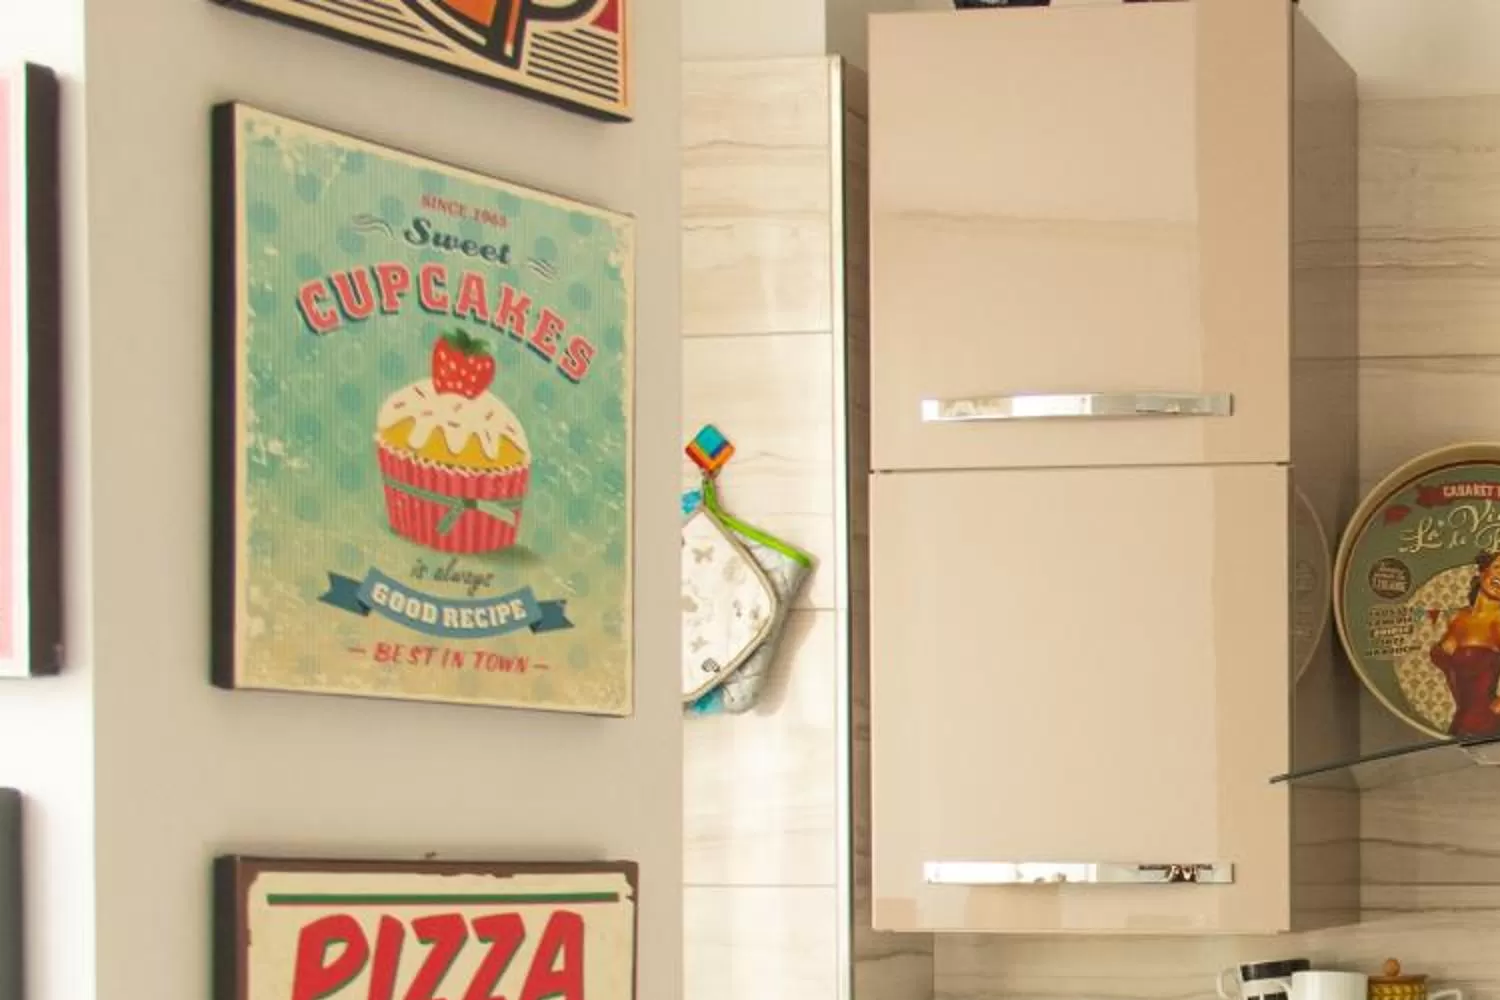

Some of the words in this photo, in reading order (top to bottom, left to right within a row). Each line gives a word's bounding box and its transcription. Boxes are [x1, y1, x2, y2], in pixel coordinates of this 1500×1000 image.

[403, 216, 512, 266] Sweet
[296, 262, 596, 384] CUPCAKES
[410, 558, 429, 580] is
[433, 557, 496, 597] always
[371, 582, 439, 626] GOOD
[442, 598, 528, 629] RECIPE
[373, 641, 437, 666] BEST
[440, 648, 465, 669] IN
[472, 650, 529, 673] TOWN
